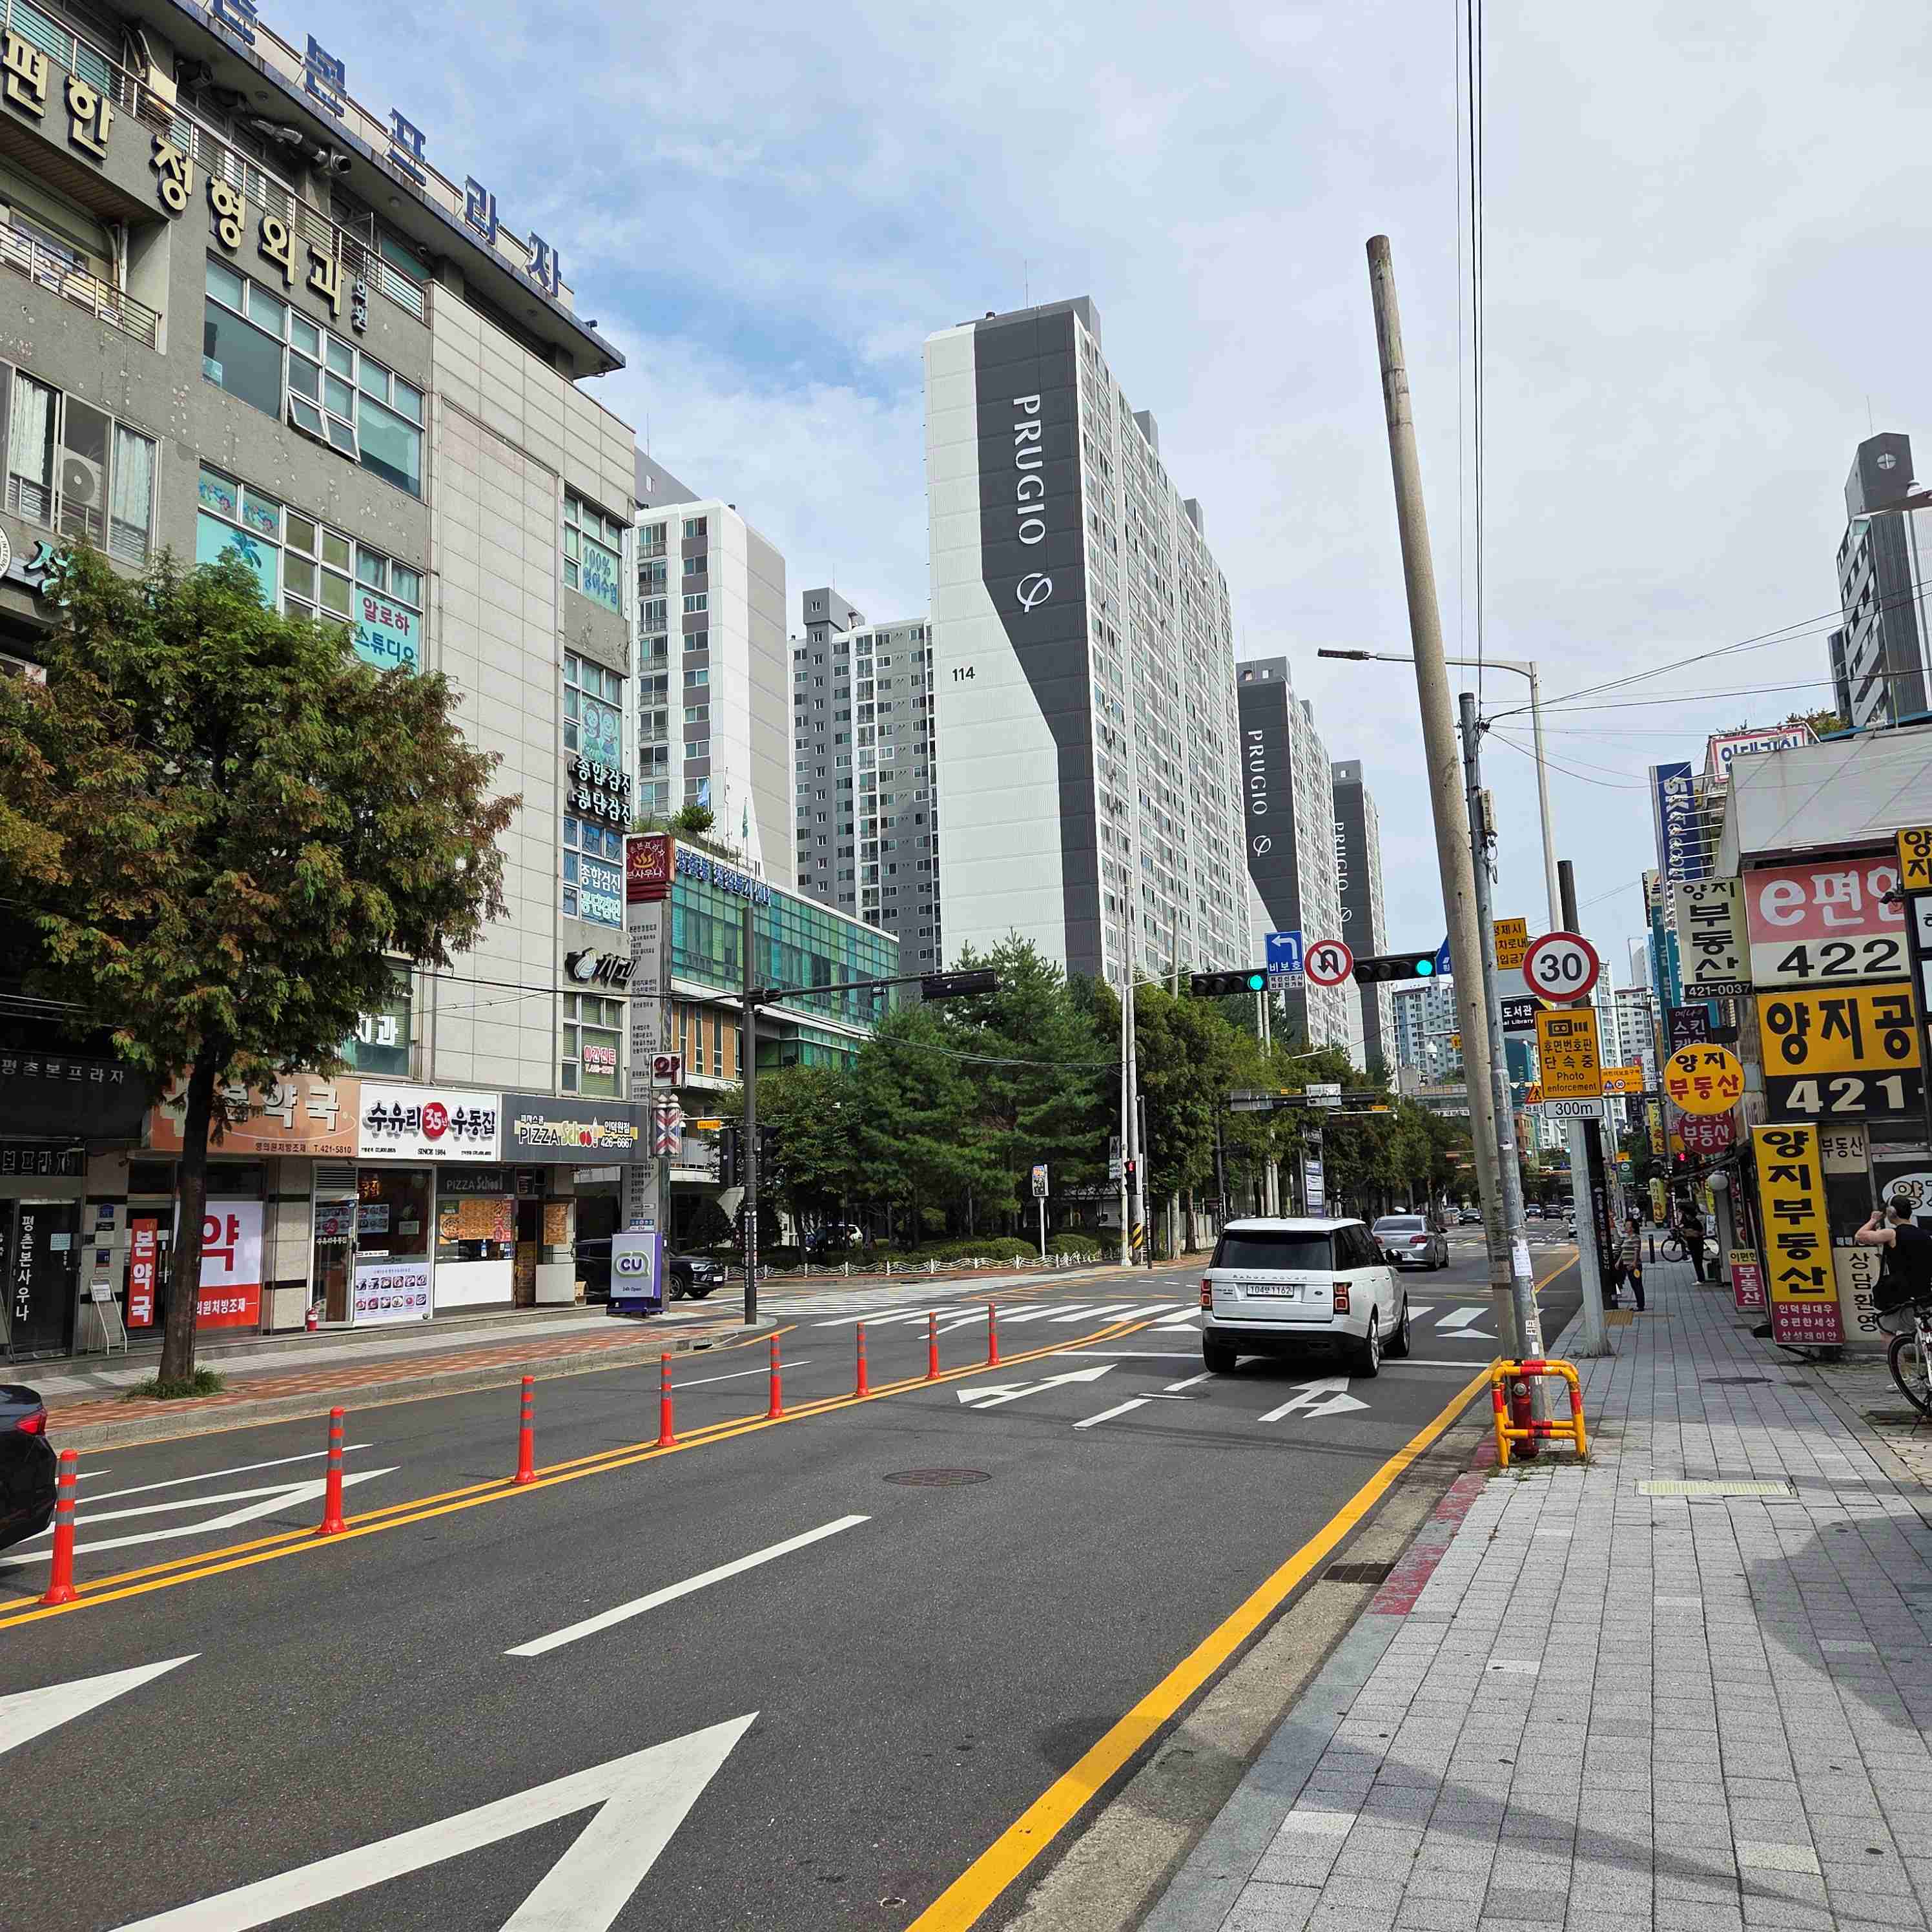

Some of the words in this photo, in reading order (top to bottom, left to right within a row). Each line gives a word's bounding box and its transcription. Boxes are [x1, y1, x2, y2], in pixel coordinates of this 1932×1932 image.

[2, 28, 115, 160] 편한
[151, 134, 347, 318] 정형외과
[1013, 394, 1046, 545] PRUGIO
[363, 597, 410, 636] 알로하
[354, 626, 417, 667] 스튜디오
[952, 666, 976, 682] 114
[577, 757, 632, 797] 종합검진
[1248, 730, 1268, 815] PRUGIO
[577, 785, 633, 826] 공단검진
[581, 864, 621, 894] 종합검진
[1683, 881, 1735, 901] 양지
[581, 890, 621, 921] 공단검진
[1495, 939, 1526, 951] 차로내
[1689, 902, 1739, 982] 부동산
[1269, 960, 1302, 972] 비보호
[1540, 953, 1581, 982] 30
[1777, 939, 1902, 978] 422
[1689, 984, 1750, 996] 421-0037
[1503, 1005, 1532, 1018] 도서관
[1674, 1019, 1705, 1035] 스킨
[1767, 994, 1915, 1065] 양지공
[1543, 1039, 1593, 1054] 후면번호판
[2, 1059, 124, 1084] 평촌본프라자
[654, 1056, 680, 1085] 약
[1544, 1054, 1594, 1069] 단속중
[1675, 1052, 1726, 1073] 양지
[1547, 1081, 1597, 1092] enforcement
[1556, 1071, 1585, 1081] Photo
[1669, 1074, 1739, 1101] 부동산
[1786, 1075, 1904, 1113] 421
[367, 1102, 420, 1132] 수유리
[451, 1106, 496, 1135] 우동집
[1555, 1103, 1593, 1116] 300m
[519, 1127, 560, 1146] PIZZA
[604, 1120, 630, 1135] 인덕원점
[1684, 1124, 1729, 1146] 부동산
[314, 1144, 352, 1153] T.421-5810
[601, 1137, 633, 1149] 426-6667
[1822, 1136, 1863, 1158] 부동산
[446, 1179, 475, 1191] PIZZA
[1762, 1131, 1827, 1294] 양지부동산
[201, 1214, 240, 1271] 약
[16, 1215, 34, 1321] 평촌본사우나
[131, 1230, 155, 1323] 본약국
[621, 1259, 642, 1271] CU
[1738, 1266, 1762, 1304] 부동산
[1849, 1252, 1877, 1332] 상담환영
[1779, 1304, 1833, 1314] 인덕원대우
[1780, 1318, 1836, 1327] e편한세상
[1782, 1331, 1837, 1341] 삼성래미안
